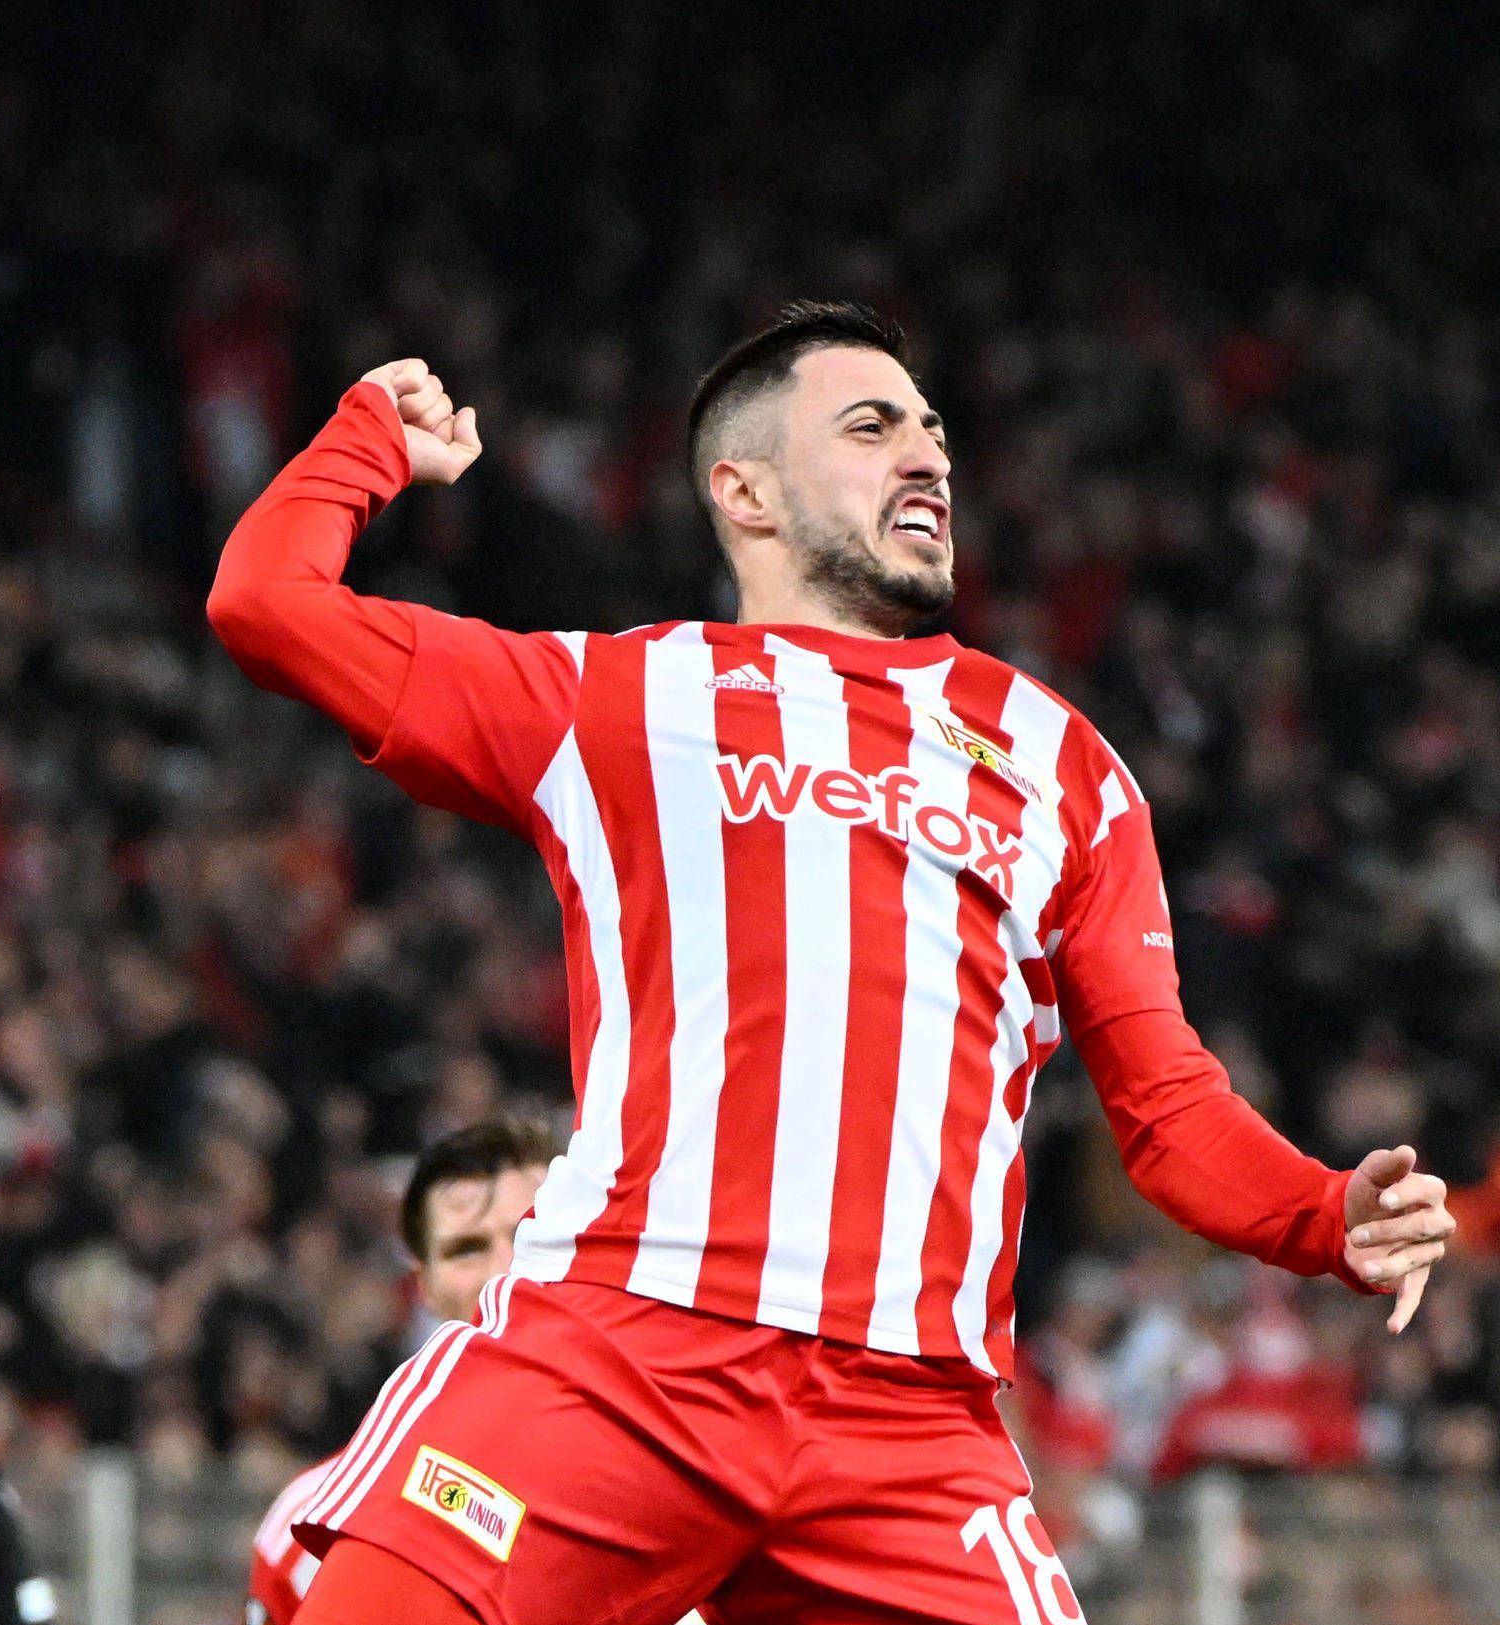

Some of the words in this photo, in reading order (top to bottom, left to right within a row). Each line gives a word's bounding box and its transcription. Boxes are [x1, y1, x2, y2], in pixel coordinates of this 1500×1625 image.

[705, 679, 785, 695] adidas
[714, 757, 1024, 902] wefox
[465, 1497, 507, 1542] UNION
